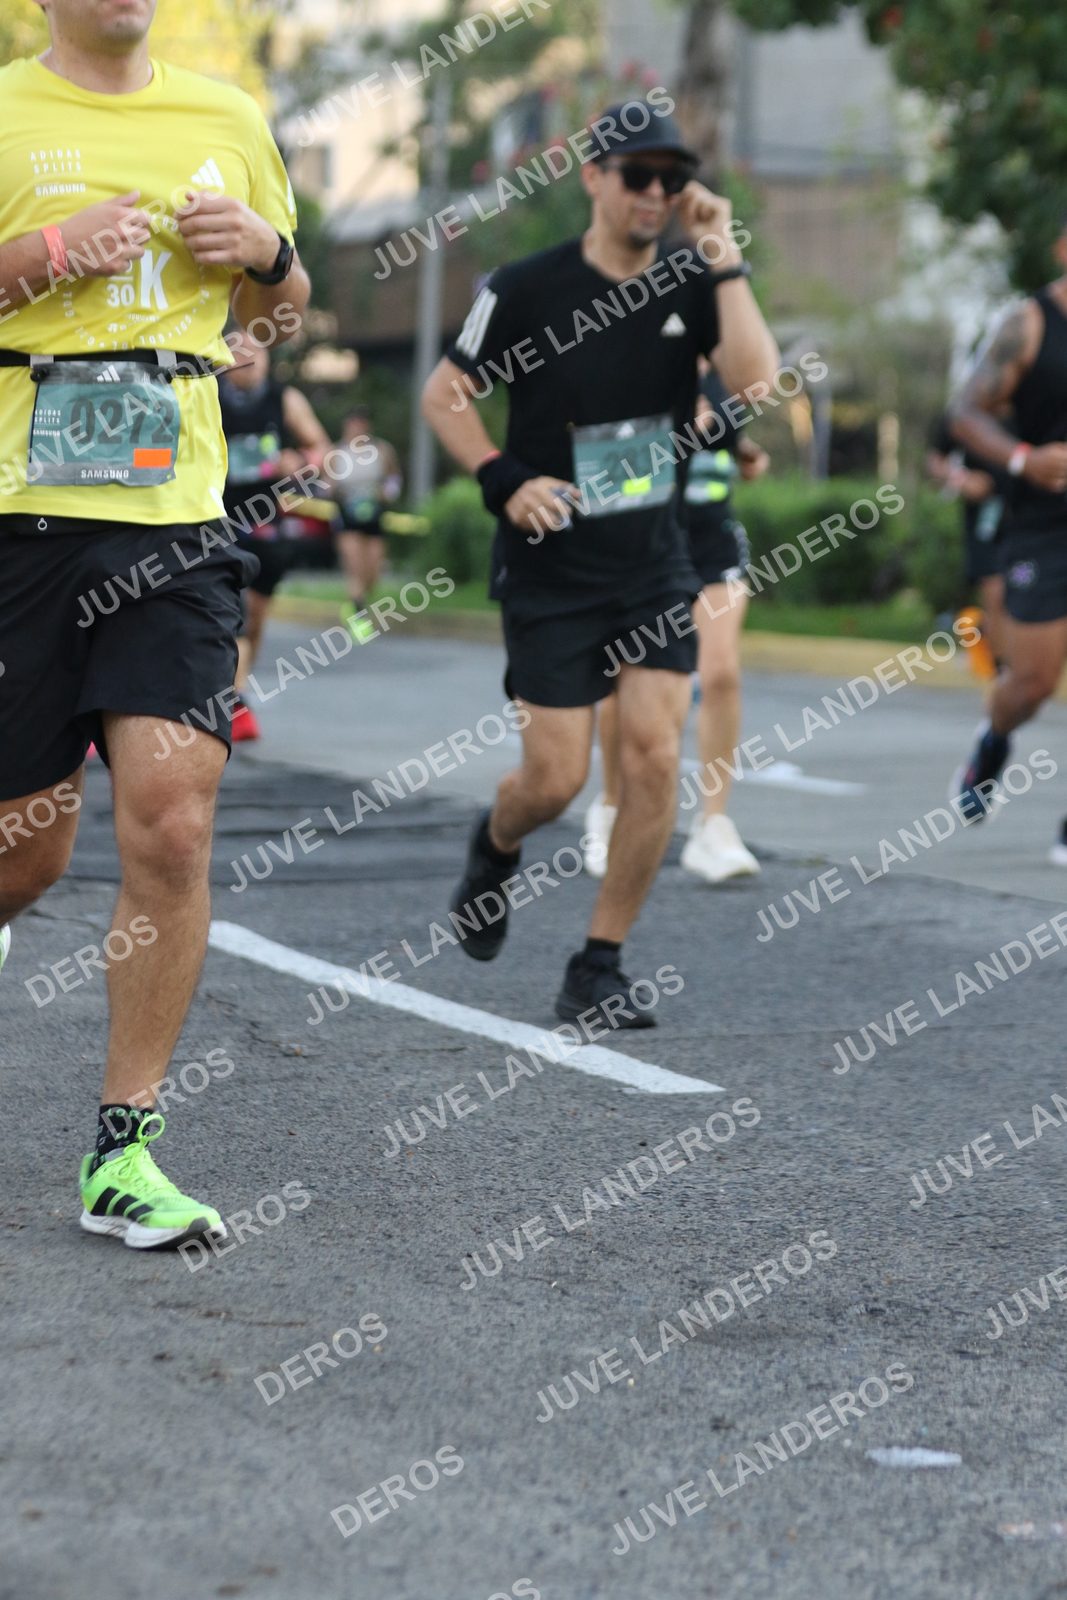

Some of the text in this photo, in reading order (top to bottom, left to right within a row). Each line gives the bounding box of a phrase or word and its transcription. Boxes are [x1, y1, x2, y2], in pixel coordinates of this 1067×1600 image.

[140, 249, 172, 311] K
[106, 283, 134, 308] 30
[80, 468, 130, 479] SAMSUNG
